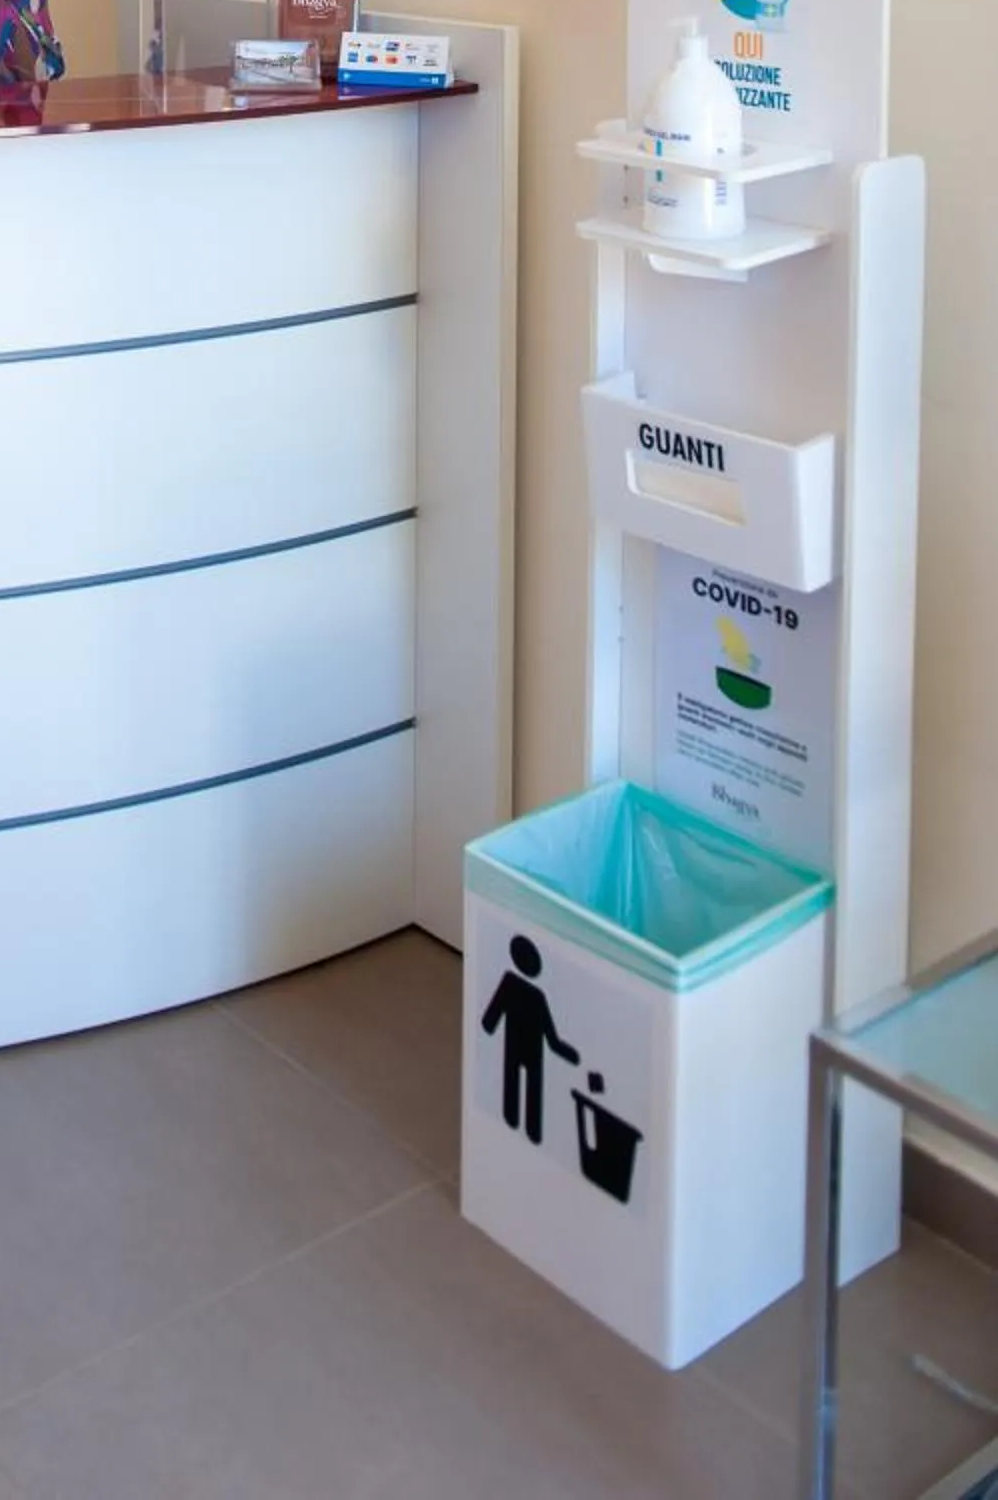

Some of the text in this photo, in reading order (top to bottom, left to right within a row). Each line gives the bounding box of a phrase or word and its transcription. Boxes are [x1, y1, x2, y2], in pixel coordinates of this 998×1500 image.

[733, 32, 764, 59] QUI
[735, 86, 792, 112] IZZANTE
[638, 423, 725, 472] GUANTI
[692, 576, 799, 630] COVID-19
